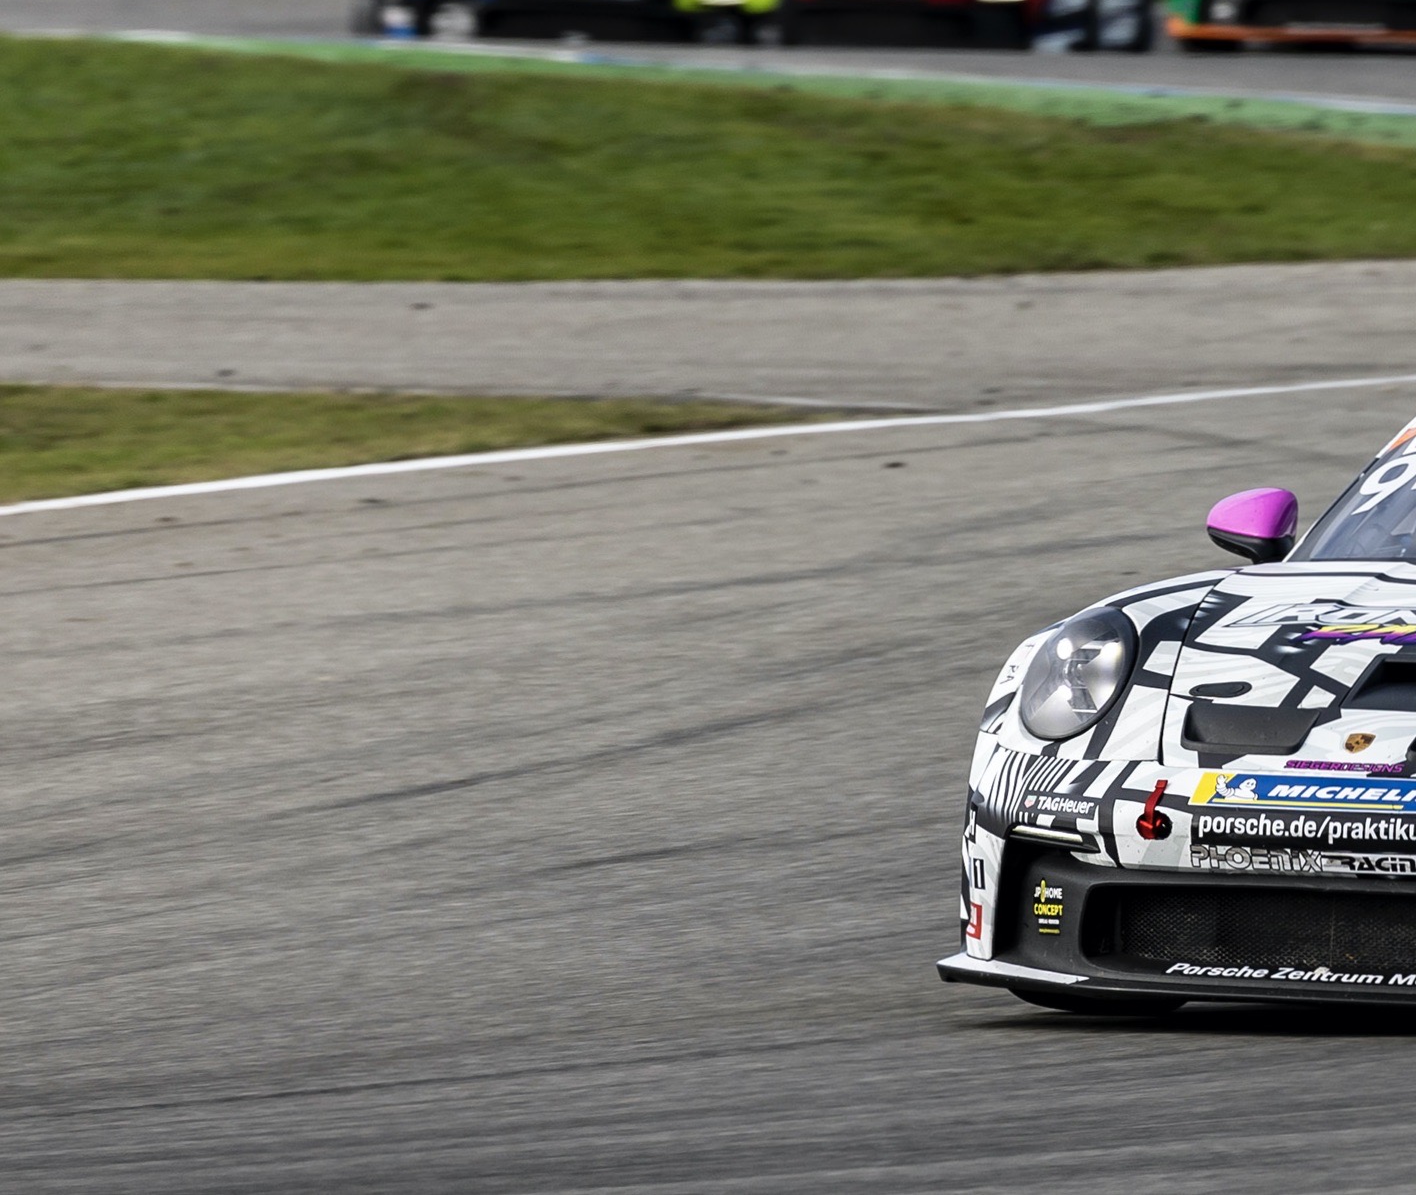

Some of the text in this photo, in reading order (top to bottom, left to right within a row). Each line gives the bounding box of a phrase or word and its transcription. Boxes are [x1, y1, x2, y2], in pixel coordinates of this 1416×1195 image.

[1036, 795, 1095, 815] TAGHeuer
[1033, 903, 1064, 917] CONCEPT
[1165, 961, 1270, 978] Porsche
[1270, 966, 1385, 986] Zentrum
